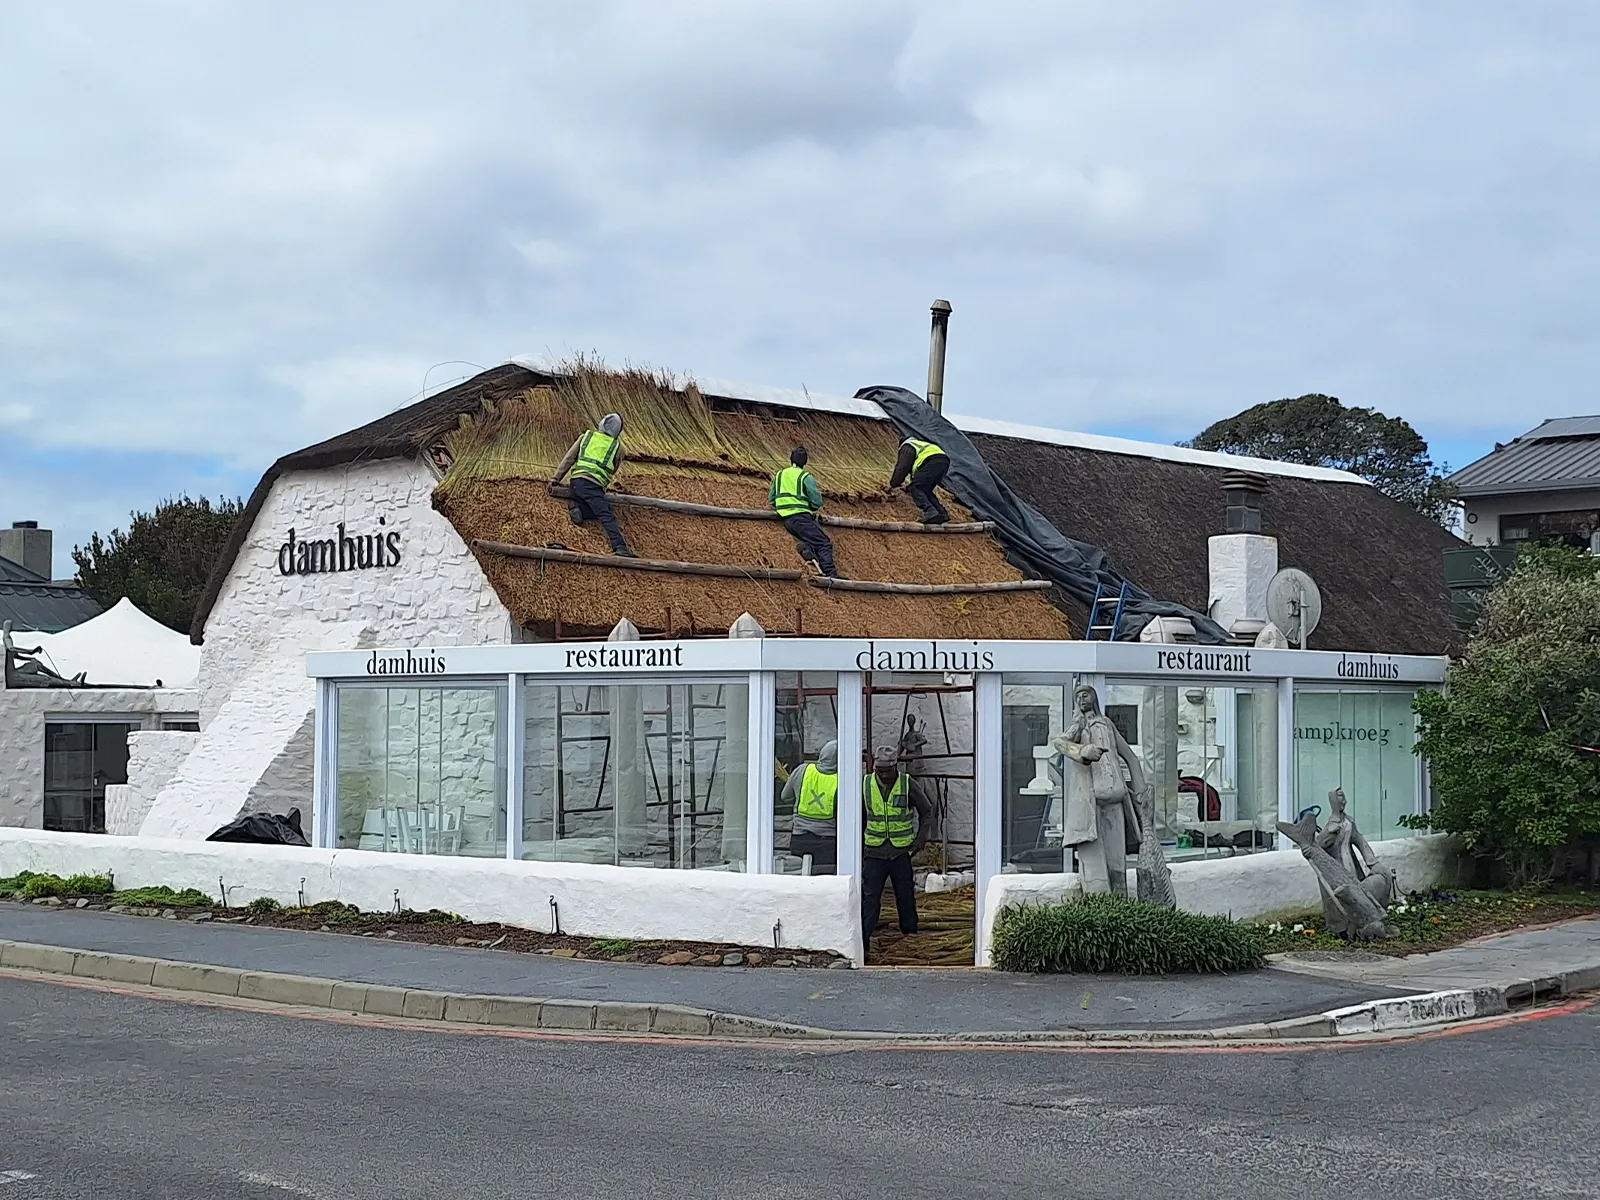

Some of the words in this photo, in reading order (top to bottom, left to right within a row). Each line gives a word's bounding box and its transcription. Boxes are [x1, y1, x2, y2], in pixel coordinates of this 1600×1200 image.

[278, 516, 401, 577] damhuis
[366, 649, 446, 675] damhuis
[565, 643, 683, 668] restaurant
[856, 641, 994, 671] damhuis
[1157, 648, 1252, 673] restaurant
[1337, 653, 1399, 680] damhuis
[1293, 721, 1390, 747] ampkroeg
